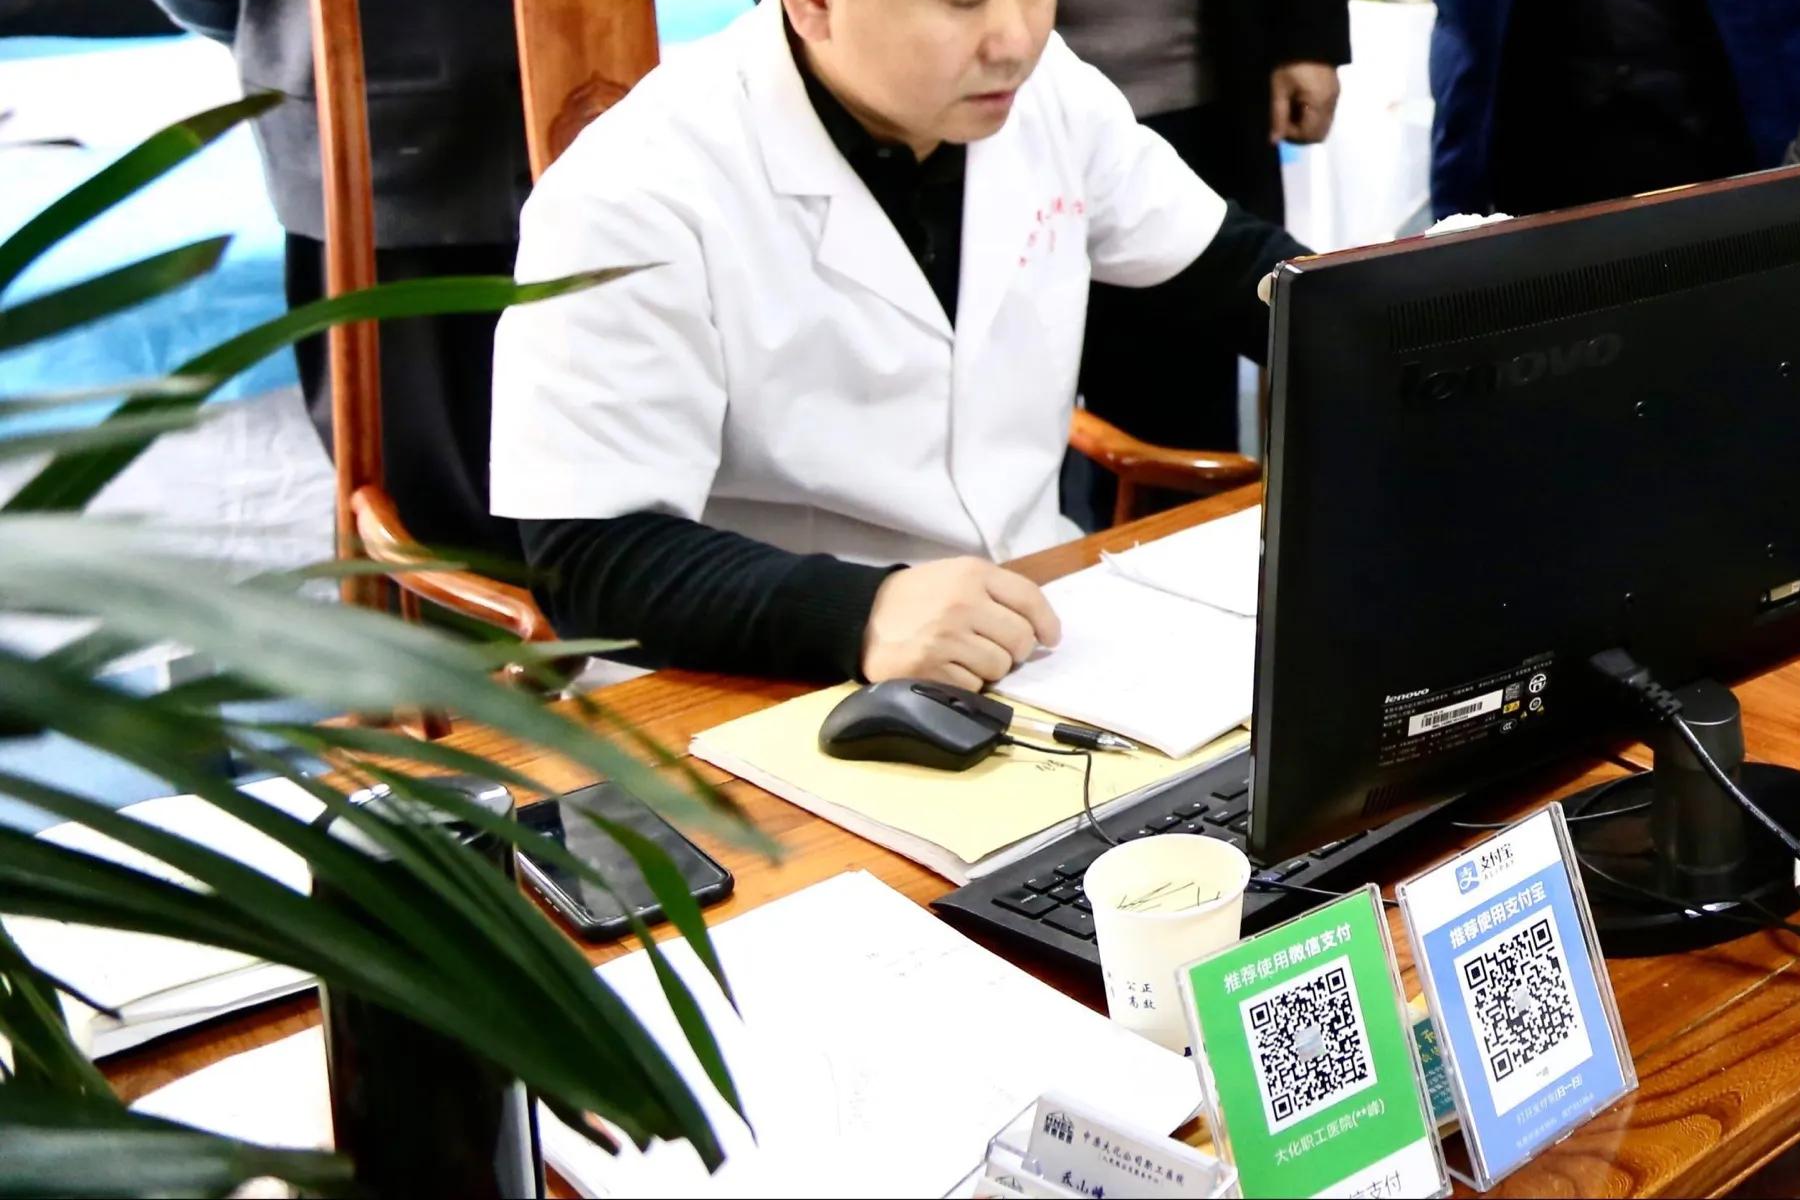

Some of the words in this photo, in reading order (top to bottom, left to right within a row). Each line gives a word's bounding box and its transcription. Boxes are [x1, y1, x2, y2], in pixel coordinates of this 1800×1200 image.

[1385, 687, 1430, 704] lenovo
[1449, 880, 1547, 949] 推荐使用支付宝
[1223, 922, 1352, 994] 推荐使用微信支付
